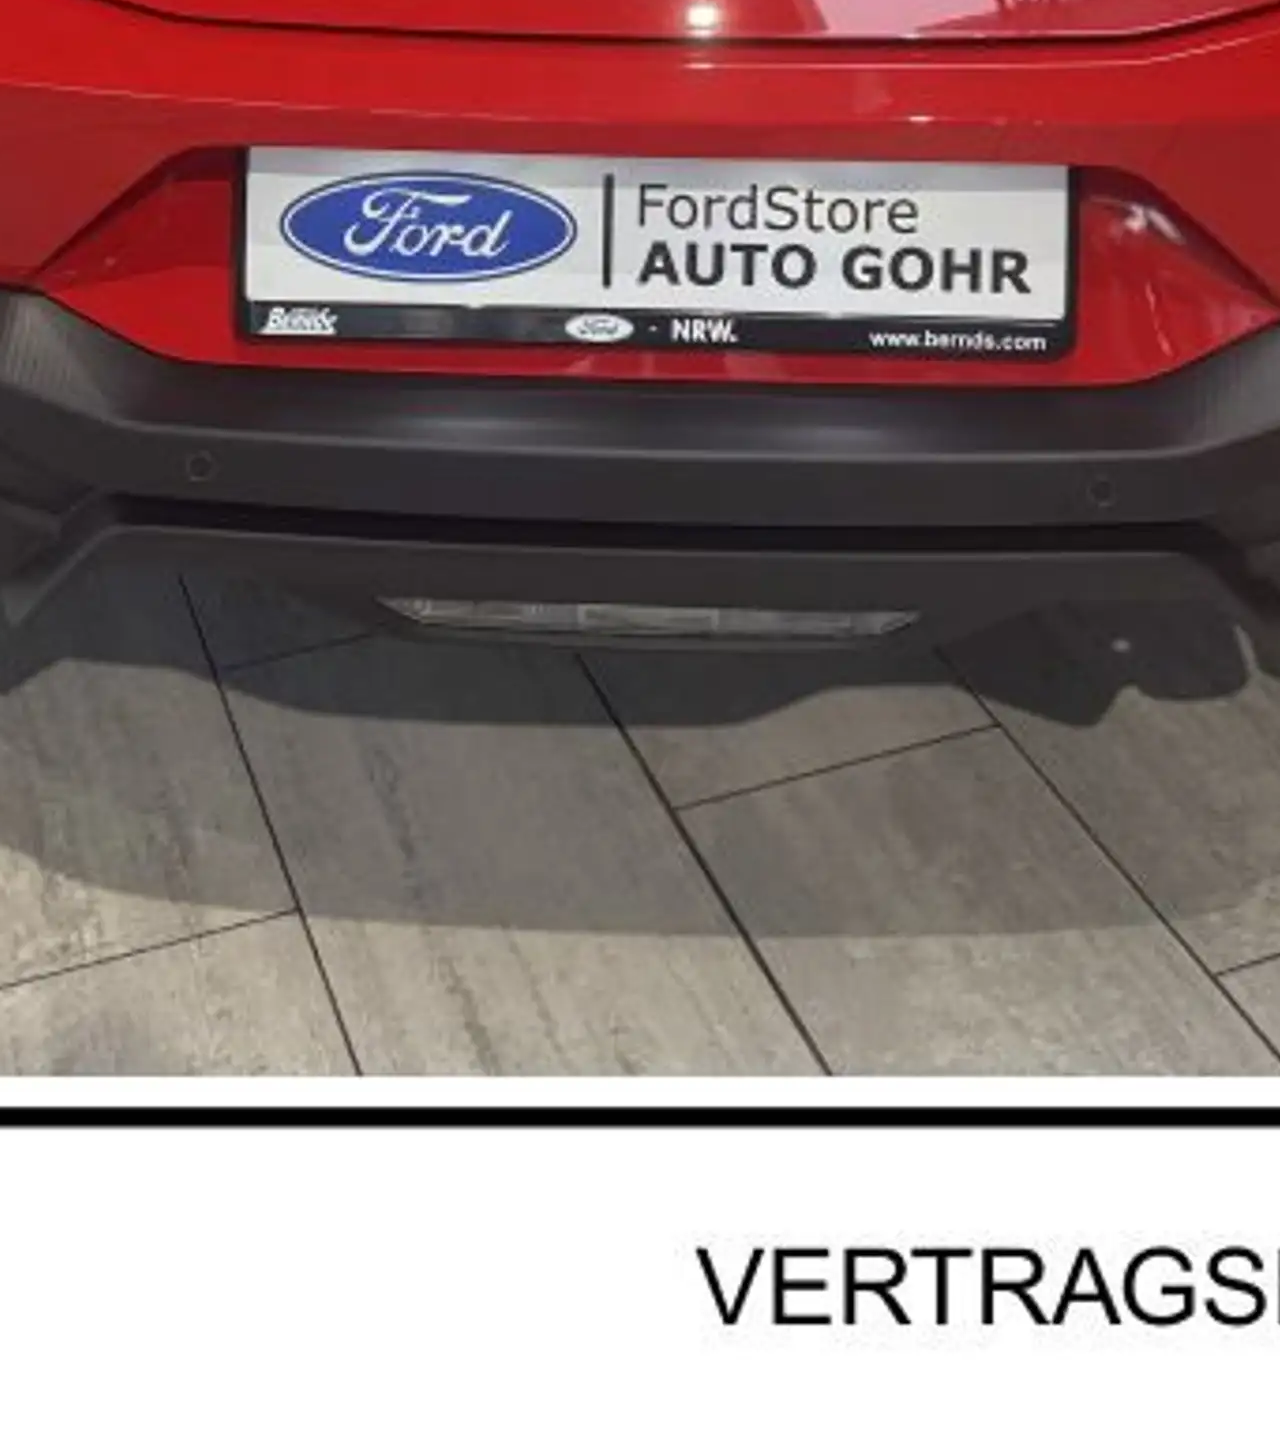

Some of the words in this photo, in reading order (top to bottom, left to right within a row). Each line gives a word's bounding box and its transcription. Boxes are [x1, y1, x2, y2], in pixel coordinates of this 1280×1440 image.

[343, 188, 514, 259] Ford
[638, 184, 920, 234] FordStore
[637, 240, 818, 290] AUTO
[841, 244, 1032, 295] GOHR
